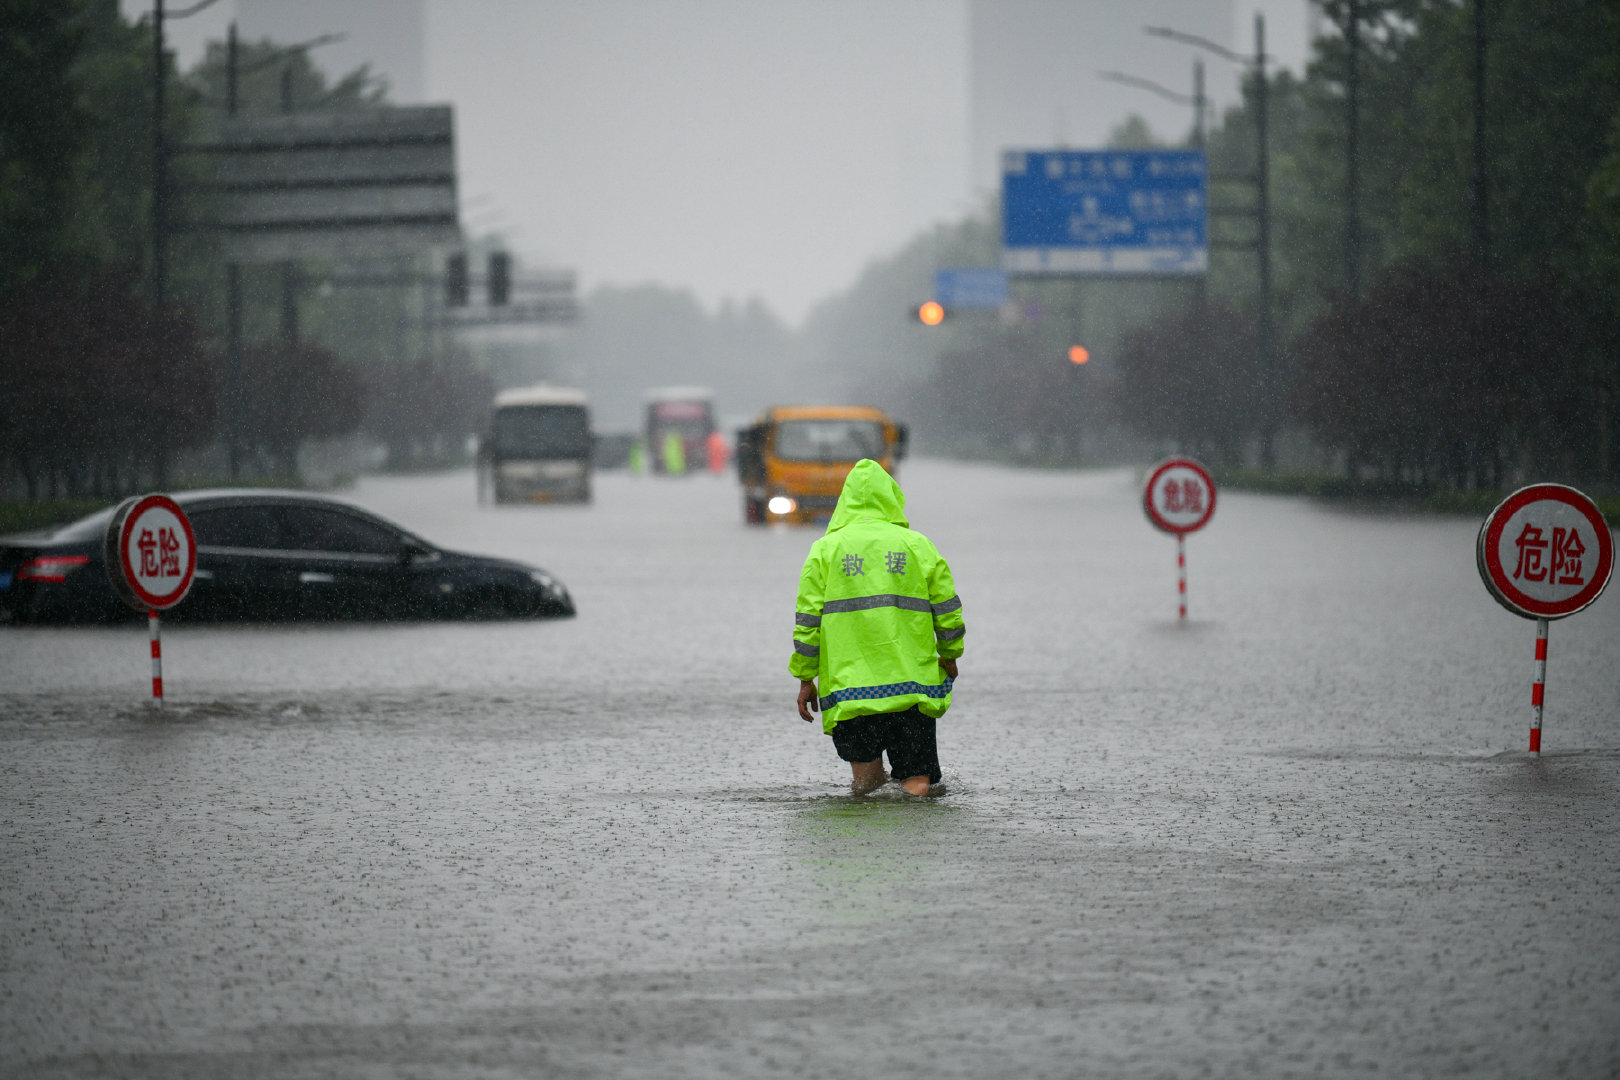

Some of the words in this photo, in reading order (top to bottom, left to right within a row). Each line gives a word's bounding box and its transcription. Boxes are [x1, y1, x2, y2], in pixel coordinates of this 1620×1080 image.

[137, 527, 180, 577] 危险
[841, 551, 906, 576] 救援
[1513, 522, 1586, 586] 危险
